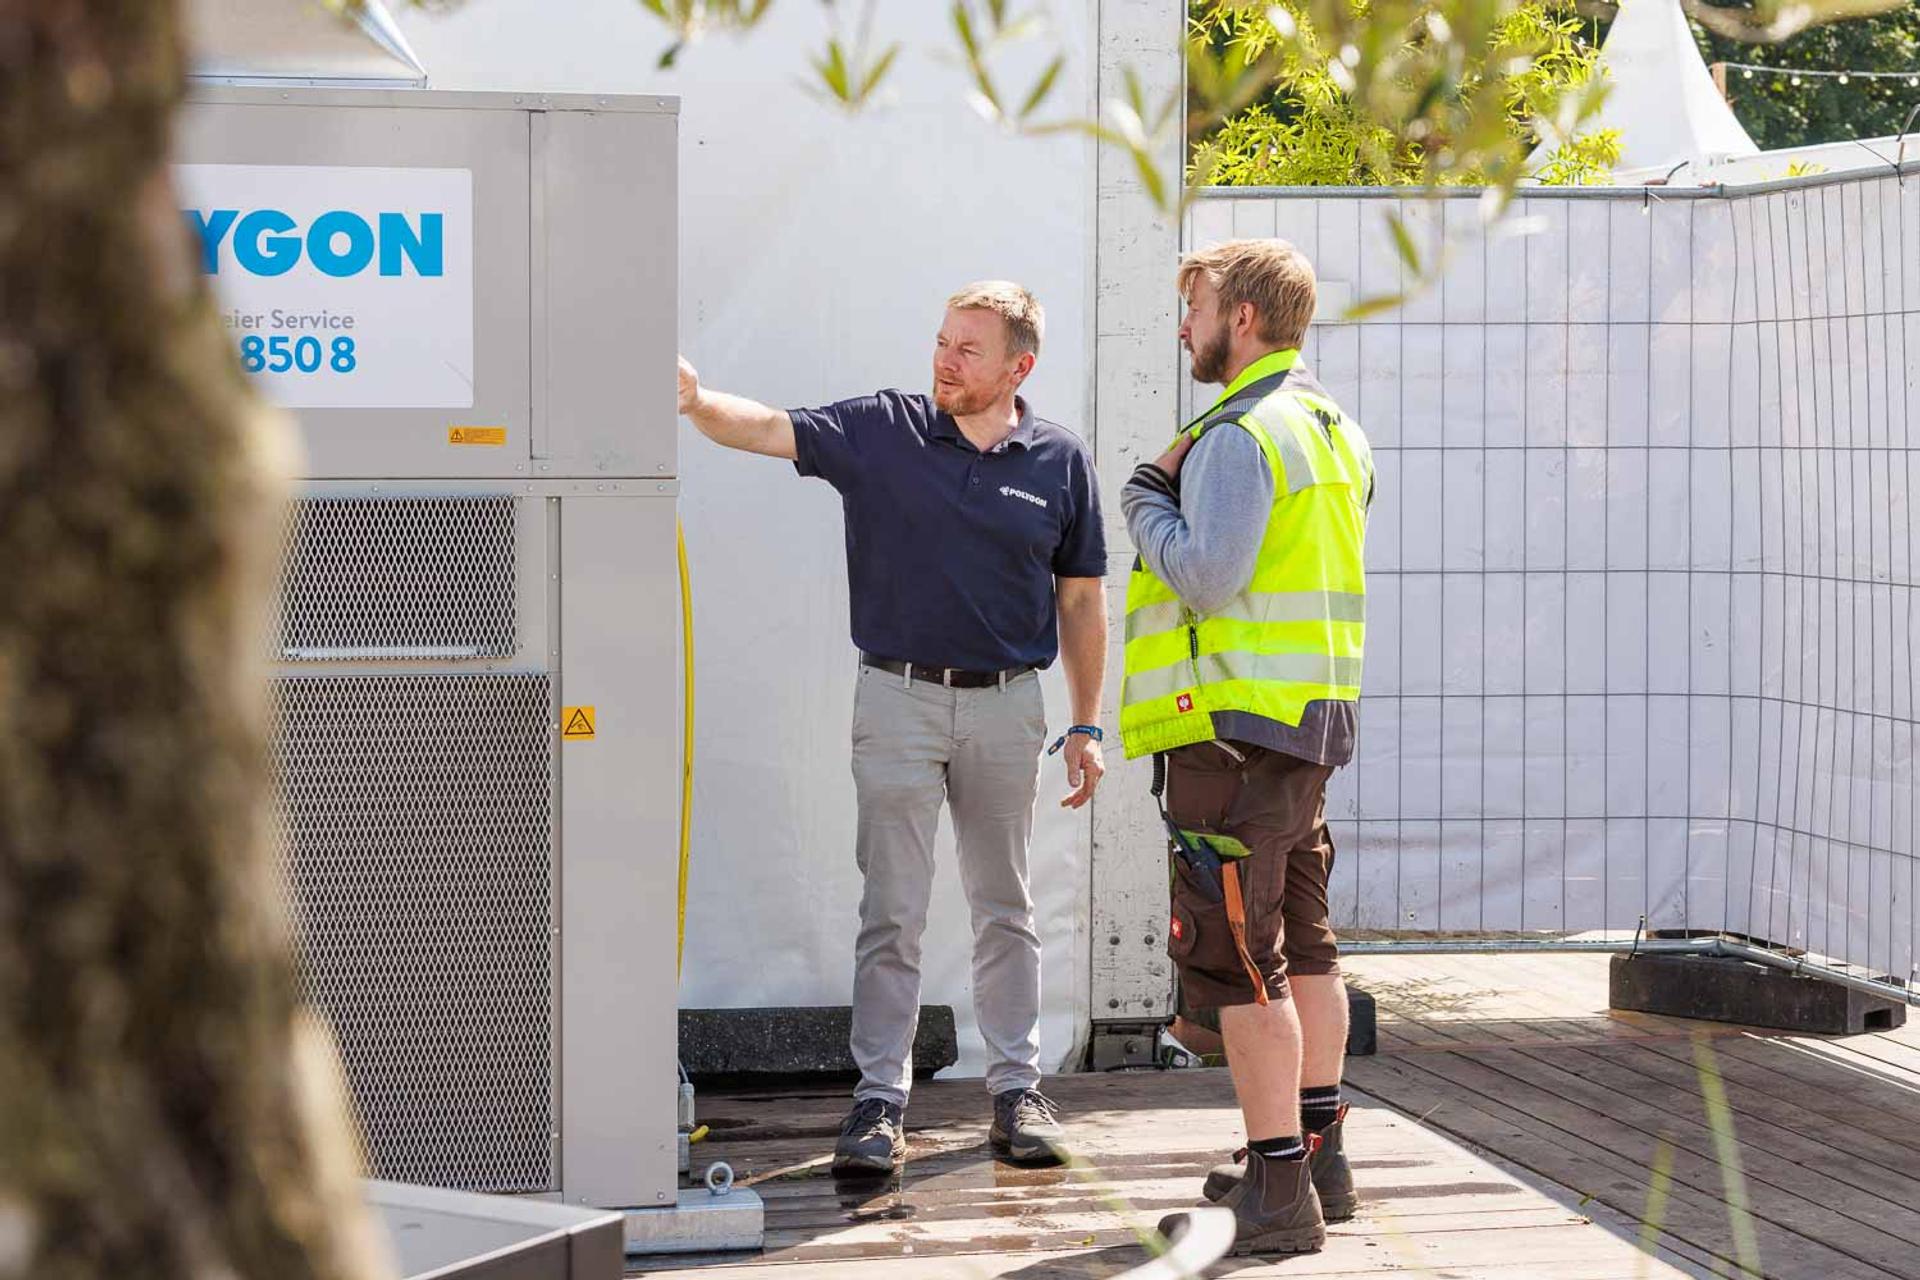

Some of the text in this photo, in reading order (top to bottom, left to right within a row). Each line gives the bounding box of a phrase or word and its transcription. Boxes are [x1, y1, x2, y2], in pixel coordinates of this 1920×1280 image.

[182, 209, 443, 277] YGON
[271, 309, 355, 329] Service
[1009, 488, 1047, 508] POLYGON
